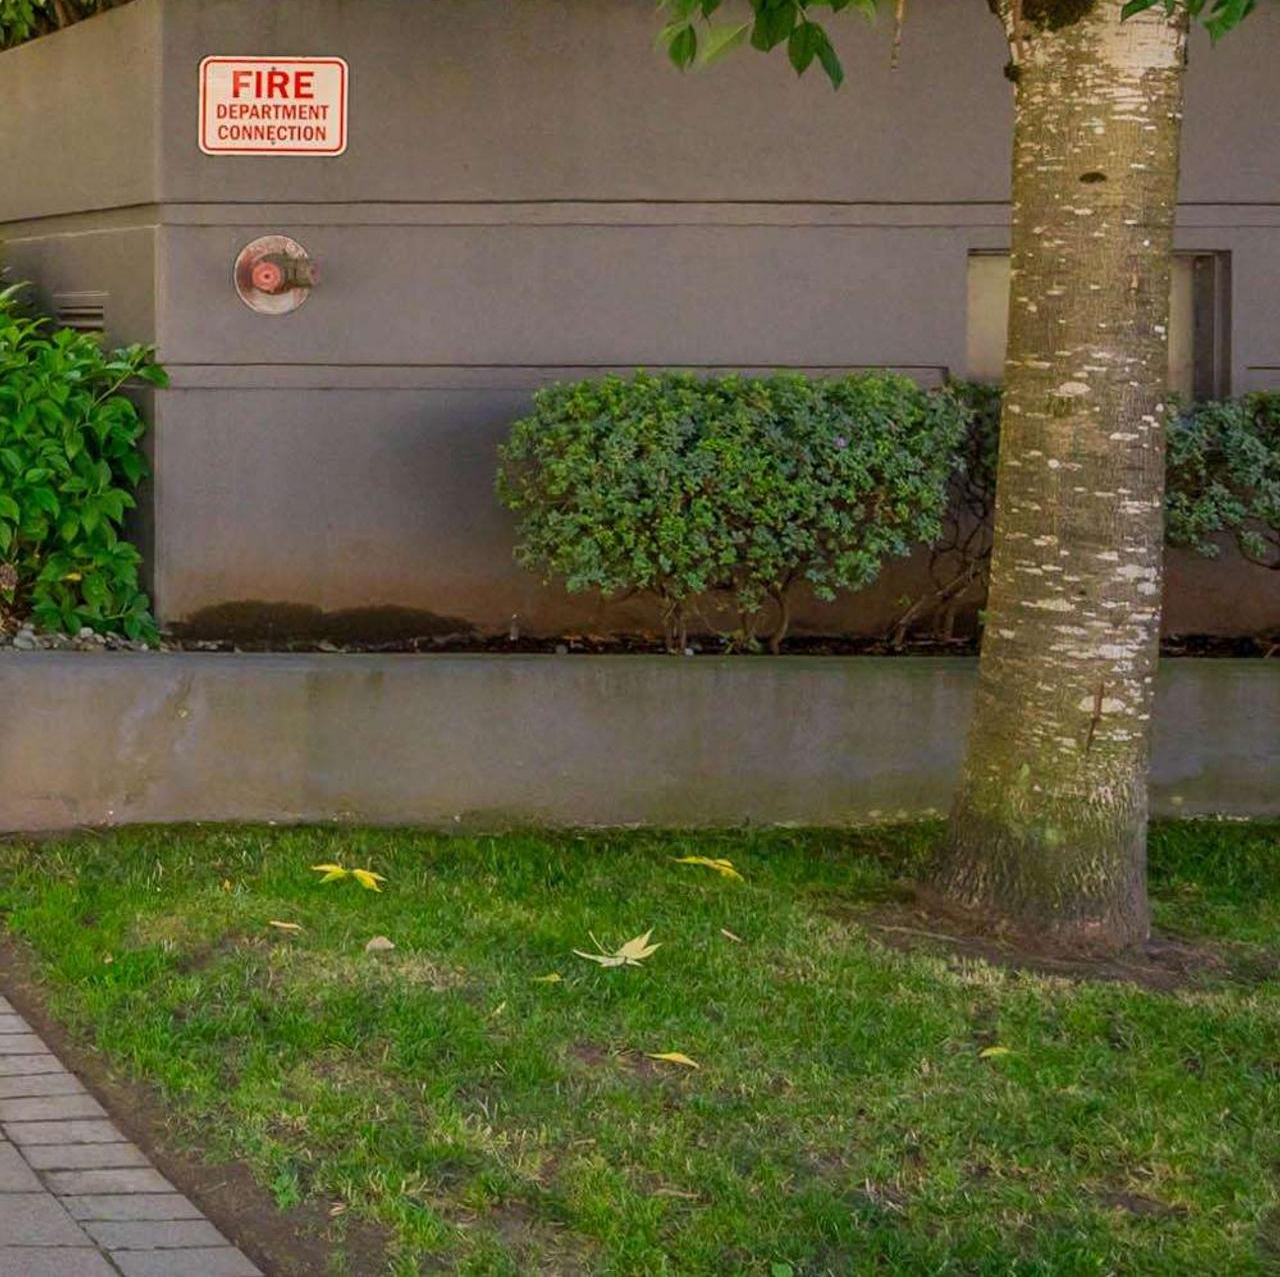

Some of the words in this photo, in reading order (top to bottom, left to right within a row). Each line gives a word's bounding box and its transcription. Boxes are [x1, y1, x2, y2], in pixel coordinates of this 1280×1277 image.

[231, 70, 315, 99] FIRE
[216, 103, 330, 121] DEPARTMENT
[217, 124, 327, 141] CONNECTION
